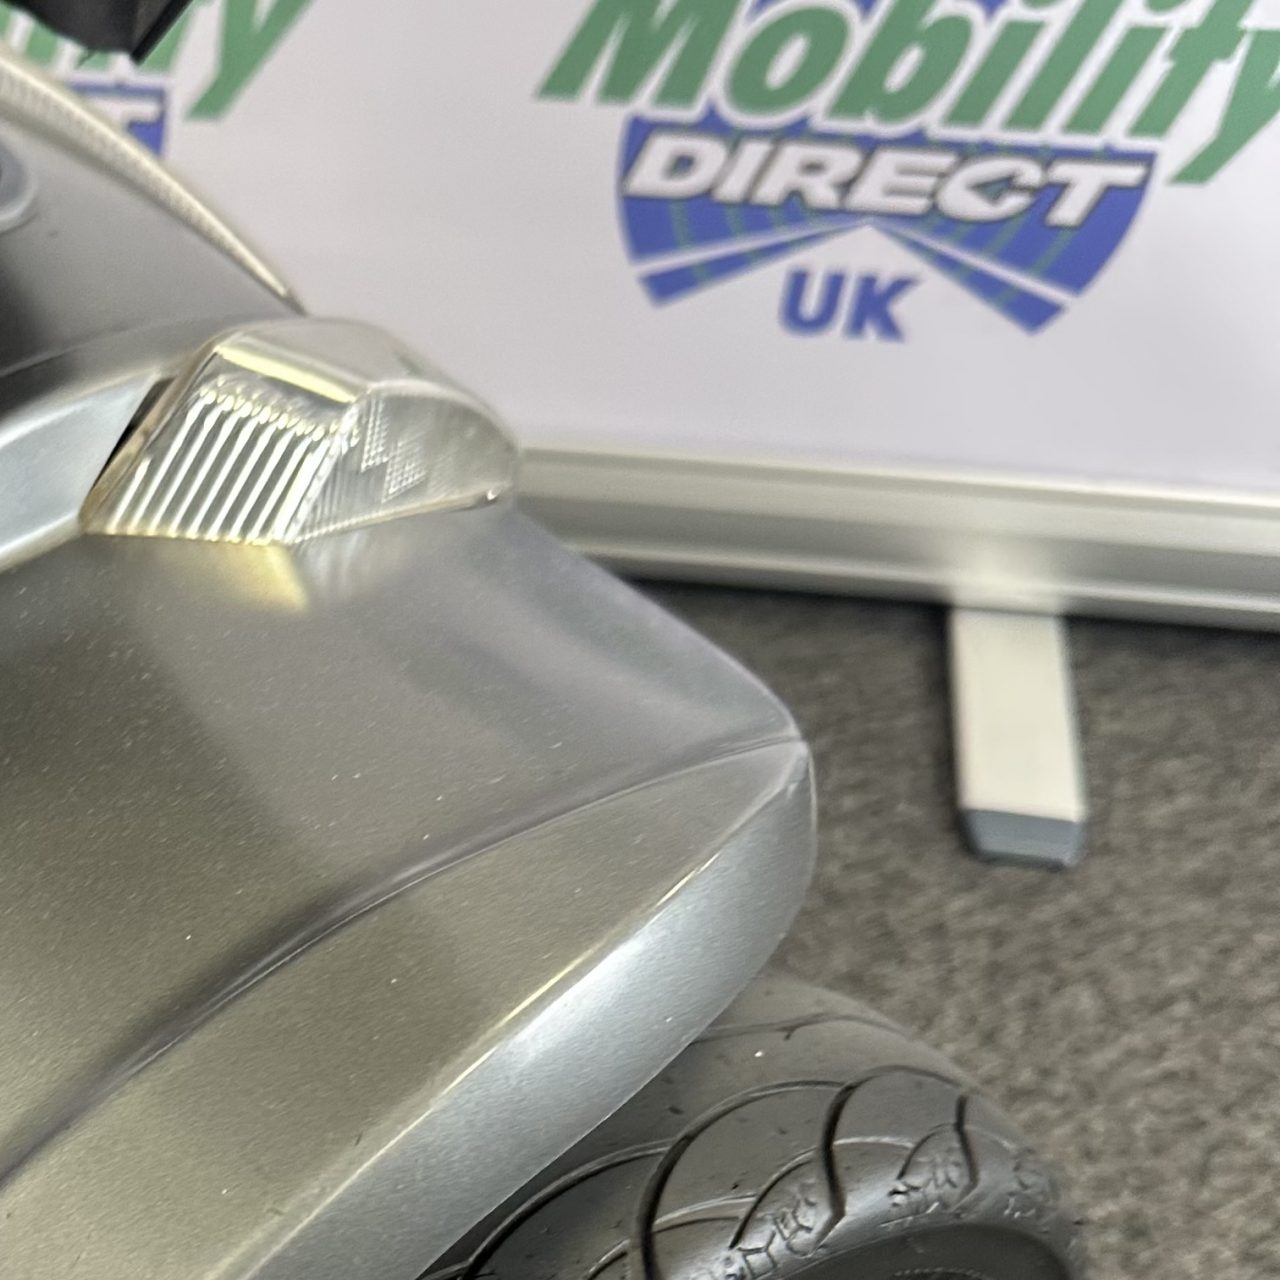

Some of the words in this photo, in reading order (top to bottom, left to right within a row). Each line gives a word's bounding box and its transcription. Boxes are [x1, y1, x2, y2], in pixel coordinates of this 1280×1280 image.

[534, 0, 1280, 186] Mobility
[622, 130, 1152, 231] DIRECT
[780, 267, 922, 342] UK
